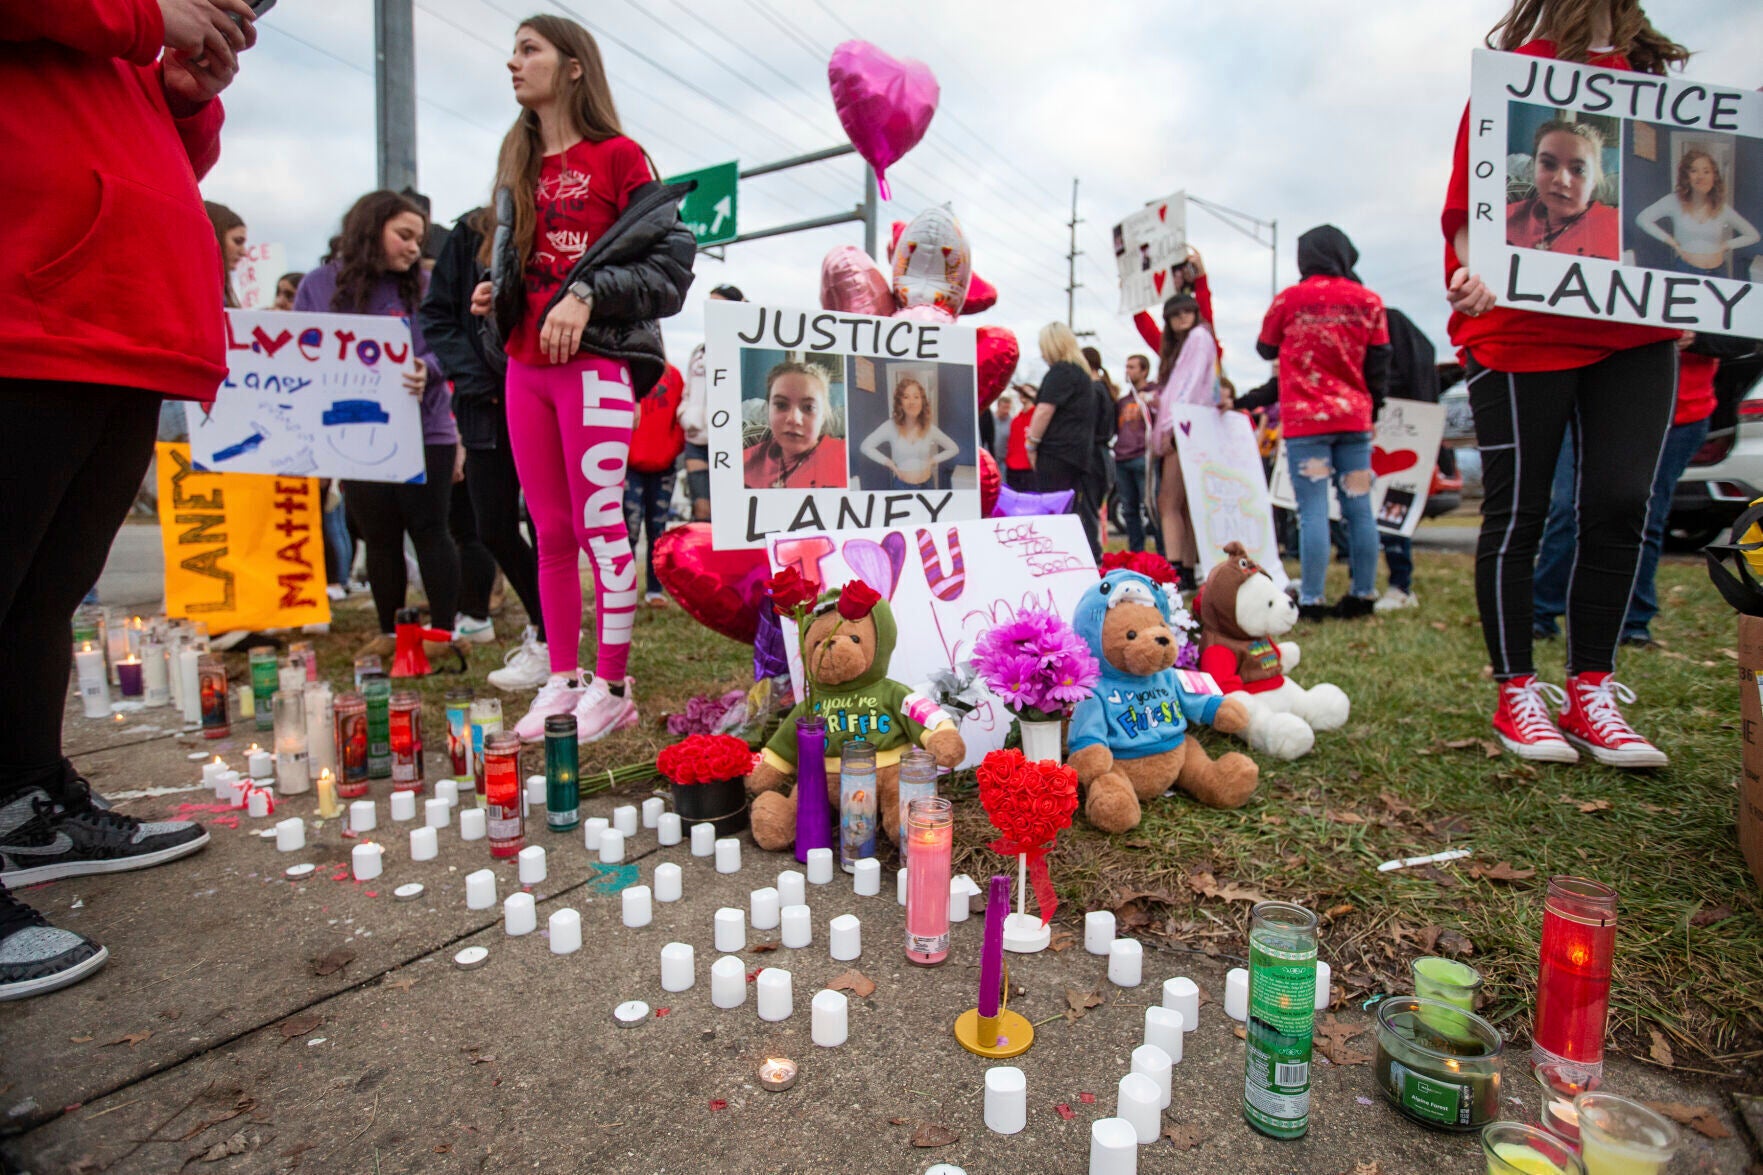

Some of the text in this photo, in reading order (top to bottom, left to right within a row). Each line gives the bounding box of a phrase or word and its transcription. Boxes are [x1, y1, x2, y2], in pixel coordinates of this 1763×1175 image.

[1506, 60, 1742, 130] JUSTICE
[1475, 119, 1495, 222] FOR
[1507, 253, 1752, 330] LANEY
[737, 307, 940, 359] JUSTICE
[711, 368, 731, 470] FOR
[580, 441, 629, 529] DO
[170, 449, 236, 614] LANEY
[822, 694, 878, 718] you're
